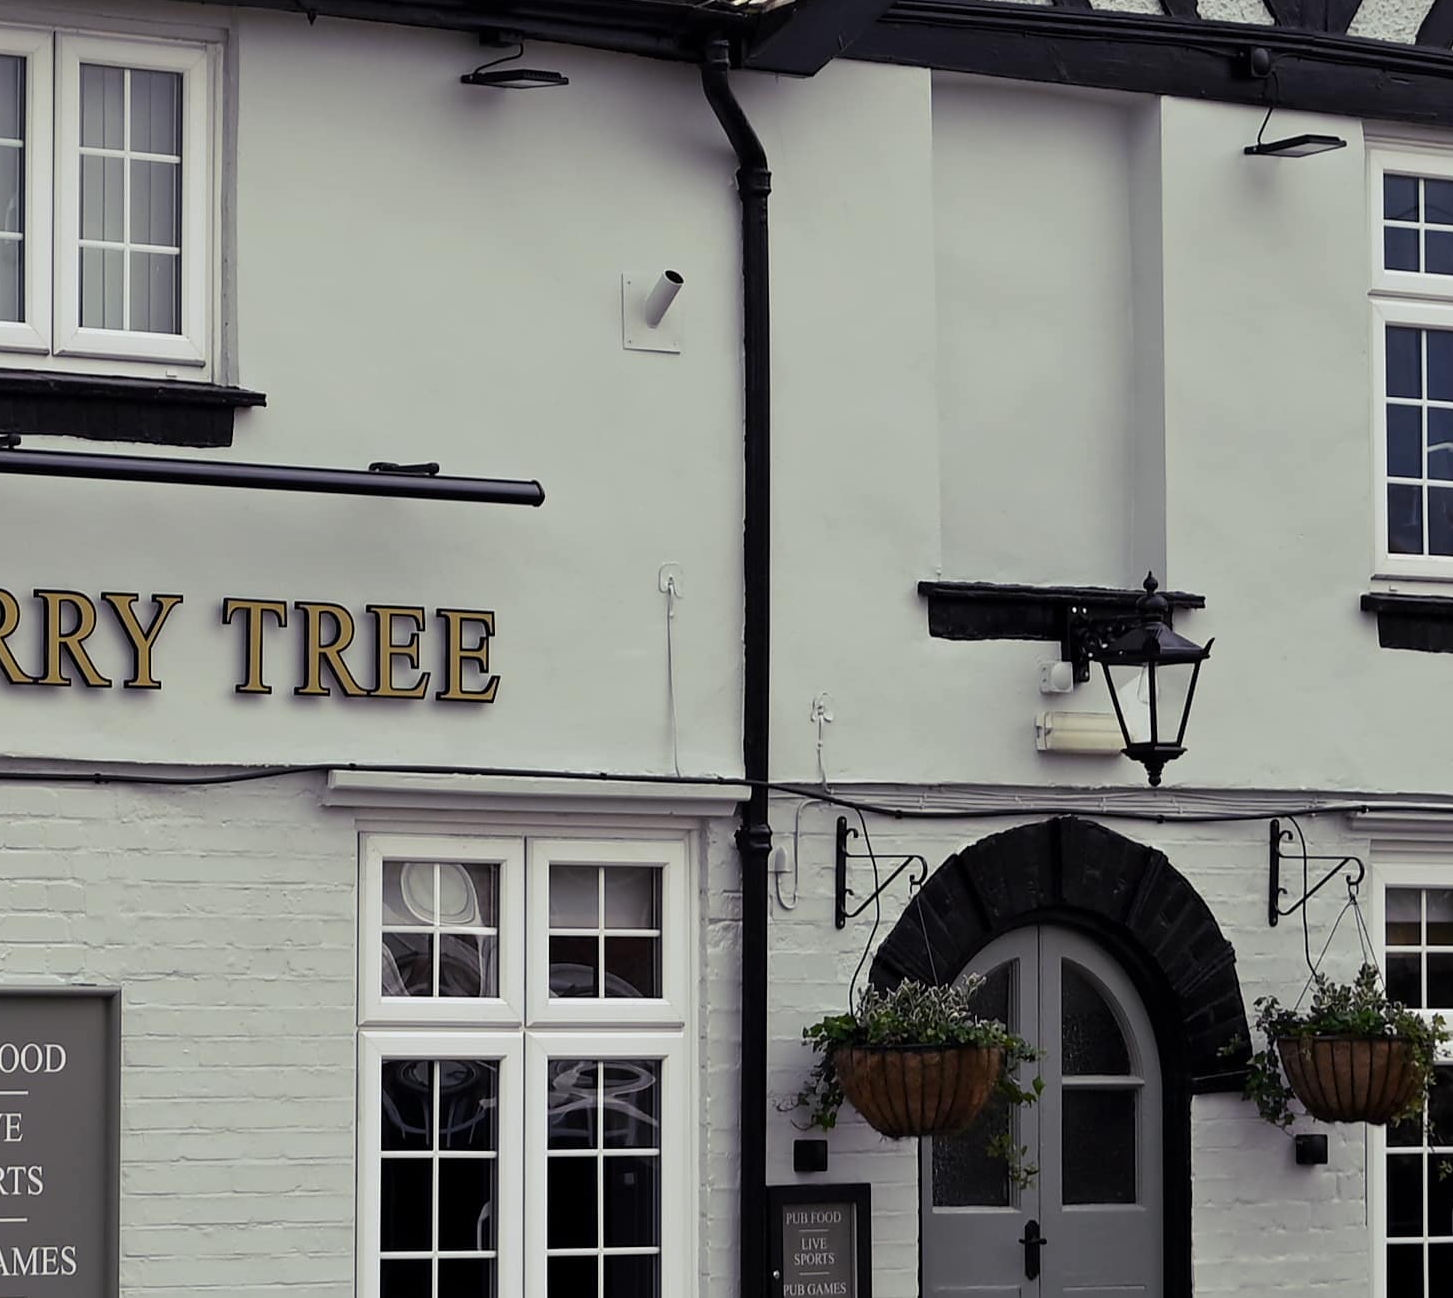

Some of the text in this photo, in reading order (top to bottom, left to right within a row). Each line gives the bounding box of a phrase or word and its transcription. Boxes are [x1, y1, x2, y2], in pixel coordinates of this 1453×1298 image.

[220, 597, 502, 703] TREE
[785, 1211, 842, 1226] PUB FOOD
[801, 1237, 828, 1250] LIVE
[794, 1252, 835, 1266] SPORTS
[783, 1282, 847, 1297] PUB GAMES
